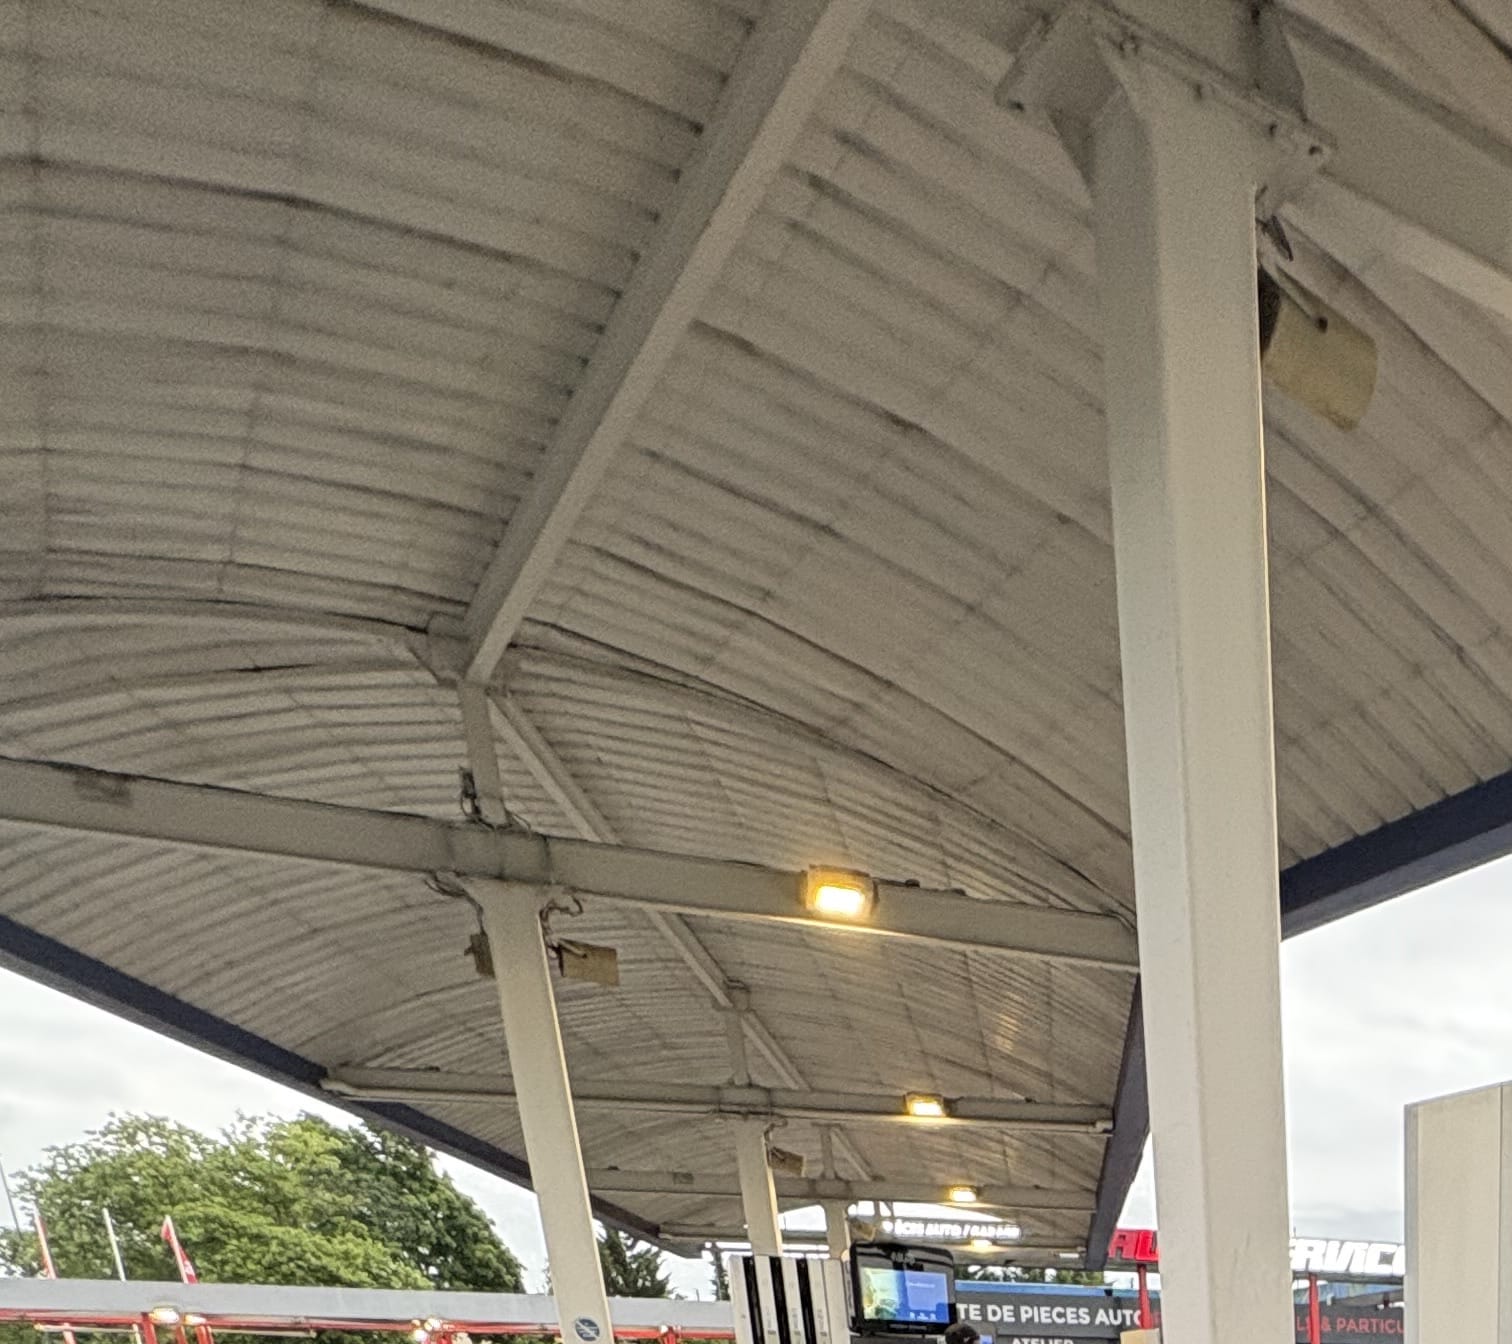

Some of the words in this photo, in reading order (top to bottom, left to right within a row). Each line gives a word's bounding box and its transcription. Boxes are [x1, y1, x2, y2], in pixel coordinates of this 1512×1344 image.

[1108, 1229, 1160, 1261] AU
[987, 1304, 1015, 1323] DE
[1020, 1305, 1090, 1326] PIECES
[1336, 1317, 1405, 1334] PARTICU
